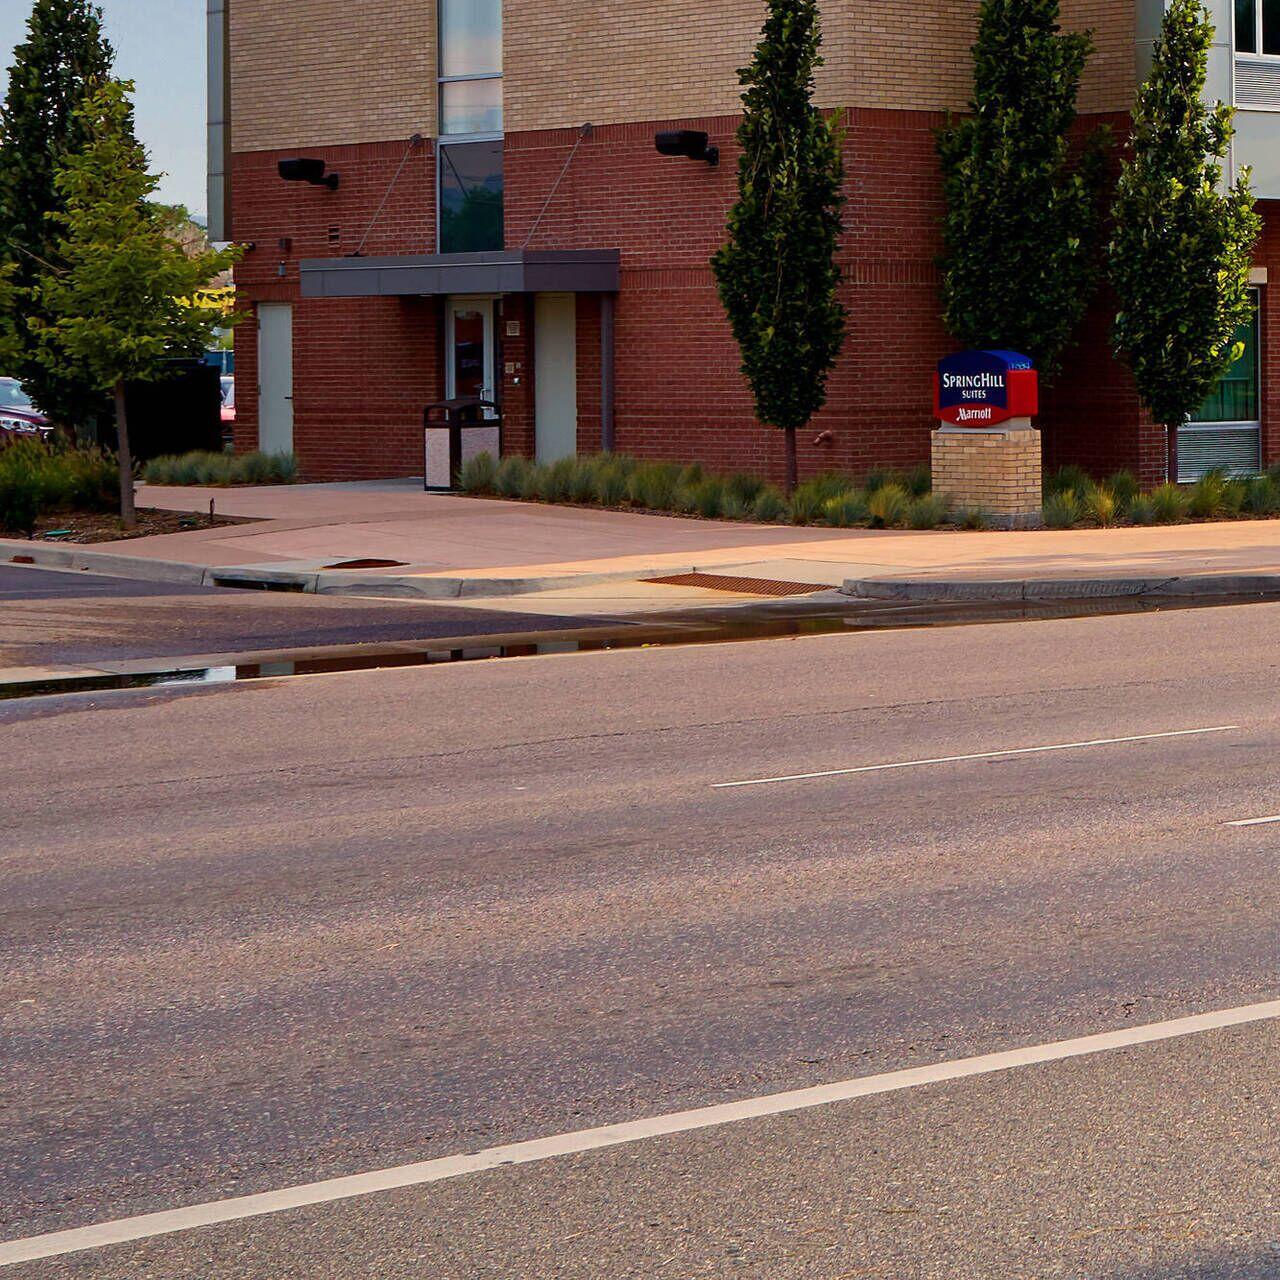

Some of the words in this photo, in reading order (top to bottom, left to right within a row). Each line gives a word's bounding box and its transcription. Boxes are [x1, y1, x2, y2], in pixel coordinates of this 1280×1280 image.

[943, 372, 1004, 388] SPRINGHILL
[961, 389, 987, 399] SUITES
[956, 407, 992, 421] Marriott
